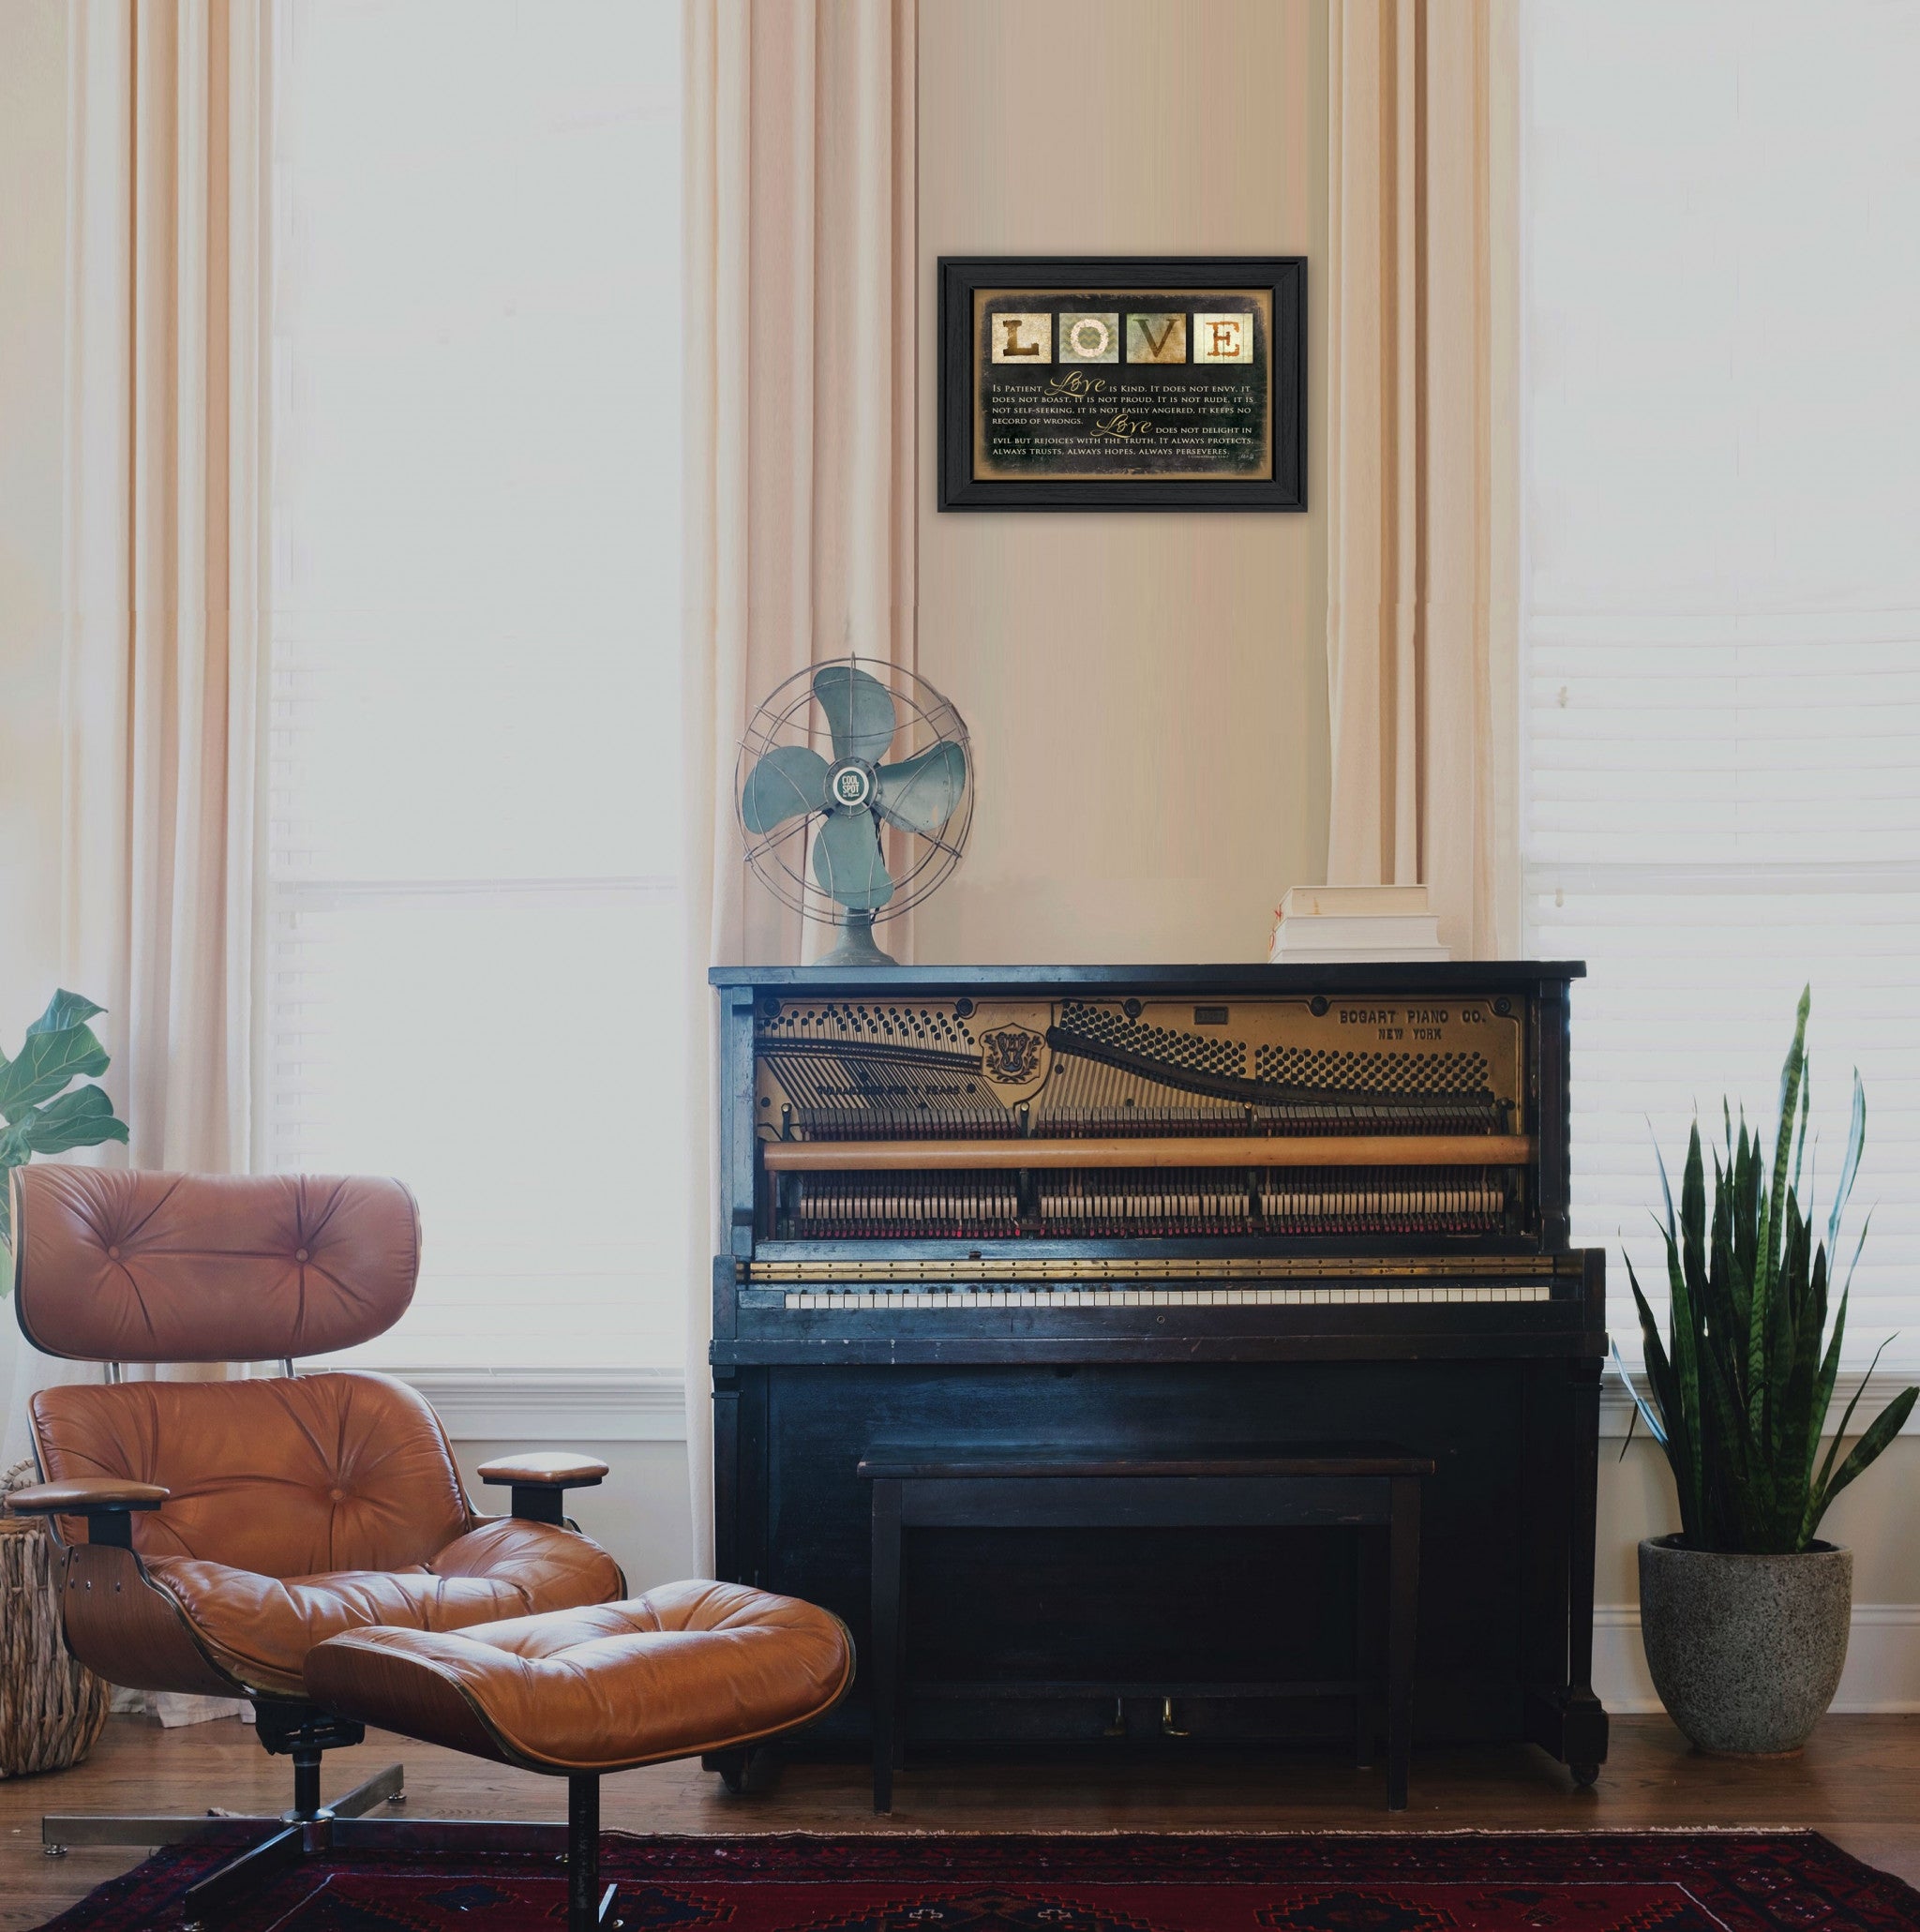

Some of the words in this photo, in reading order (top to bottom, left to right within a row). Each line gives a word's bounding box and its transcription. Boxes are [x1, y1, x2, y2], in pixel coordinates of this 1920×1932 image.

[1002, 318, 1241, 357] LOVE
[1044, 371, 1105, 397] Love
[1090, 413, 1151, 438] Love
[842, 775, 859, 785] COOL
[842, 785, 860, 793] SPOT
[1340, 1010, 1397, 1024] BOGART
[1407, 1010, 1448, 1024] PIANO
[1462, 1010, 1487, 1024] CO.
[1378, 1028, 1403, 1041] NEW
[1413, 1028, 1442, 1041] YORK
